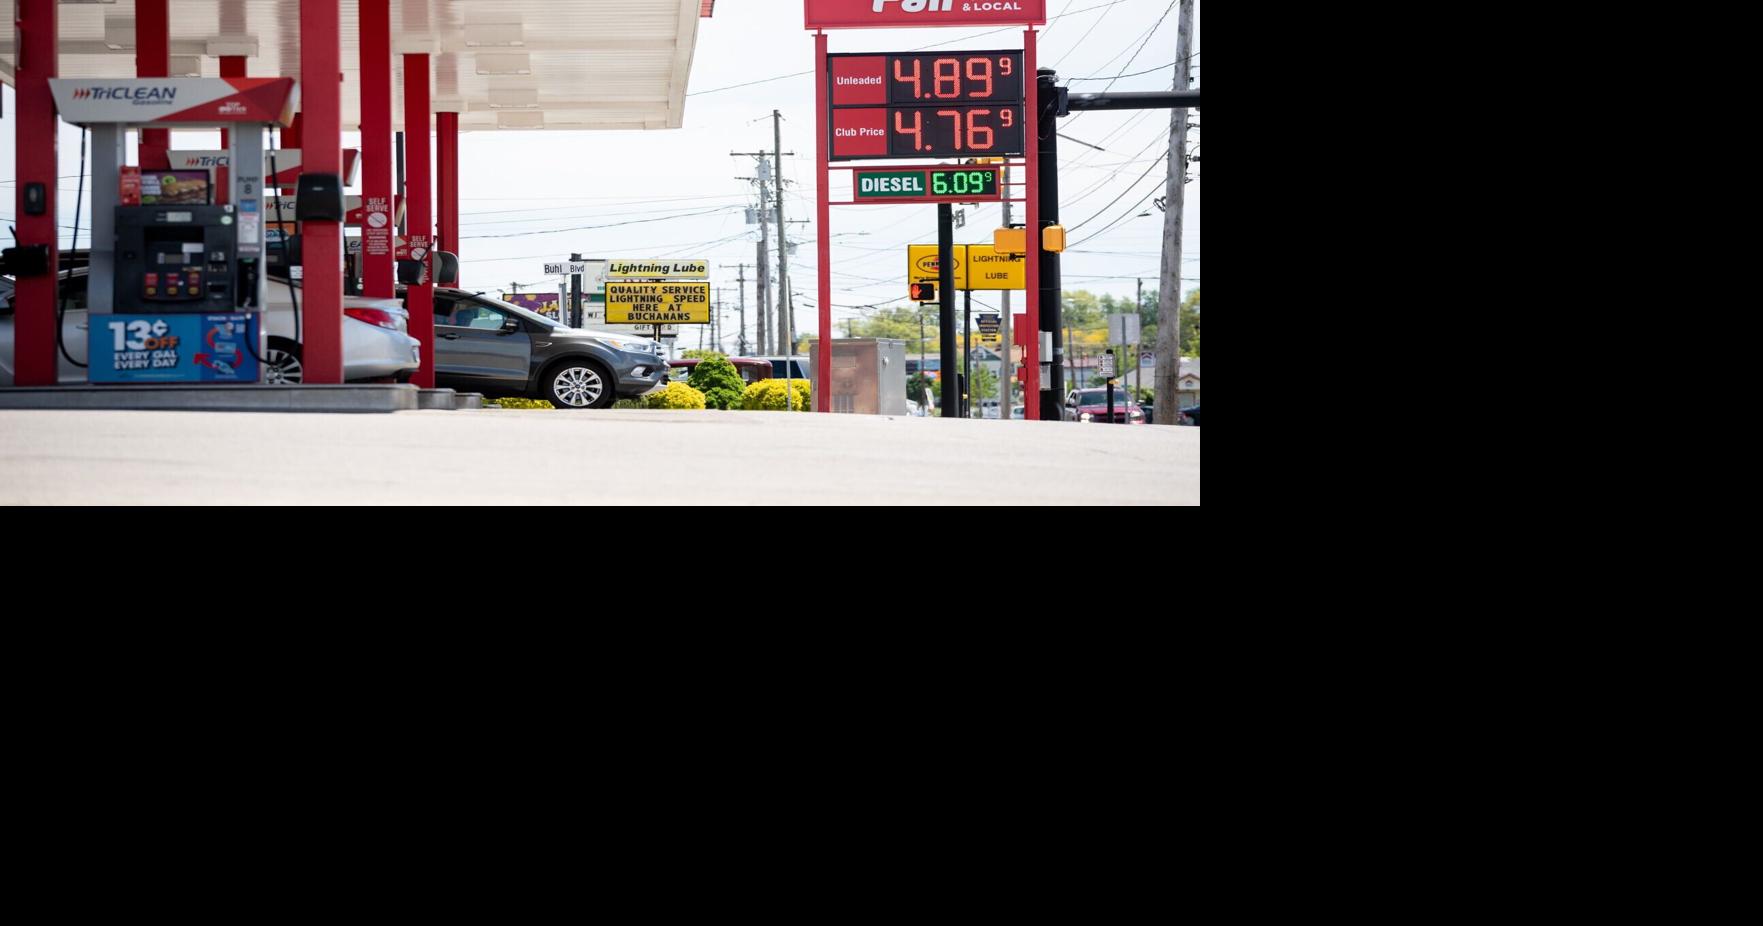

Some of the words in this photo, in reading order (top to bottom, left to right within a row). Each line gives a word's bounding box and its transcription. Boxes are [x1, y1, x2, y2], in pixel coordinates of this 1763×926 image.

[962, 3, 971, 12] &
[974, 1, 1022, 11] LOCAL
[836, 76, 882, 86] Unleaded
[91, 87, 177, 100] TriCLEAN
[835, 127, 857, 137] Club
[859, 127, 885, 137] Price
[244, 183, 252, 194] 8
[861, 177, 923, 193] DIESEL
[368, 197, 386, 205] SELF
[366, 204, 389, 212] SERVE
[544, 264, 563, 274] Buhl
[570, 264, 585, 273] Blvd
[609, 263, 670, 275] Lightning
[673, 262, 705, 273] Lube
[985, 272, 1009, 280] LUBE
[610, 286, 657, 294] QUALITY
[662, 286, 706, 294] SERVICE
[609, 294, 663, 303] LIGHTNING
[673, 294, 706, 303] SPEED
[633, 303, 659, 312] HERE
[668, 303, 682, 312] AT
[627, 312, 691, 321] BUCHANANS
[144, 336, 179, 351] OFF
[114, 351, 149, 361] EVERY
[153, 350, 178, 360] GAL
[114, 360, 149, 370] EVERY
[153, 359, 177, 368] DAY
